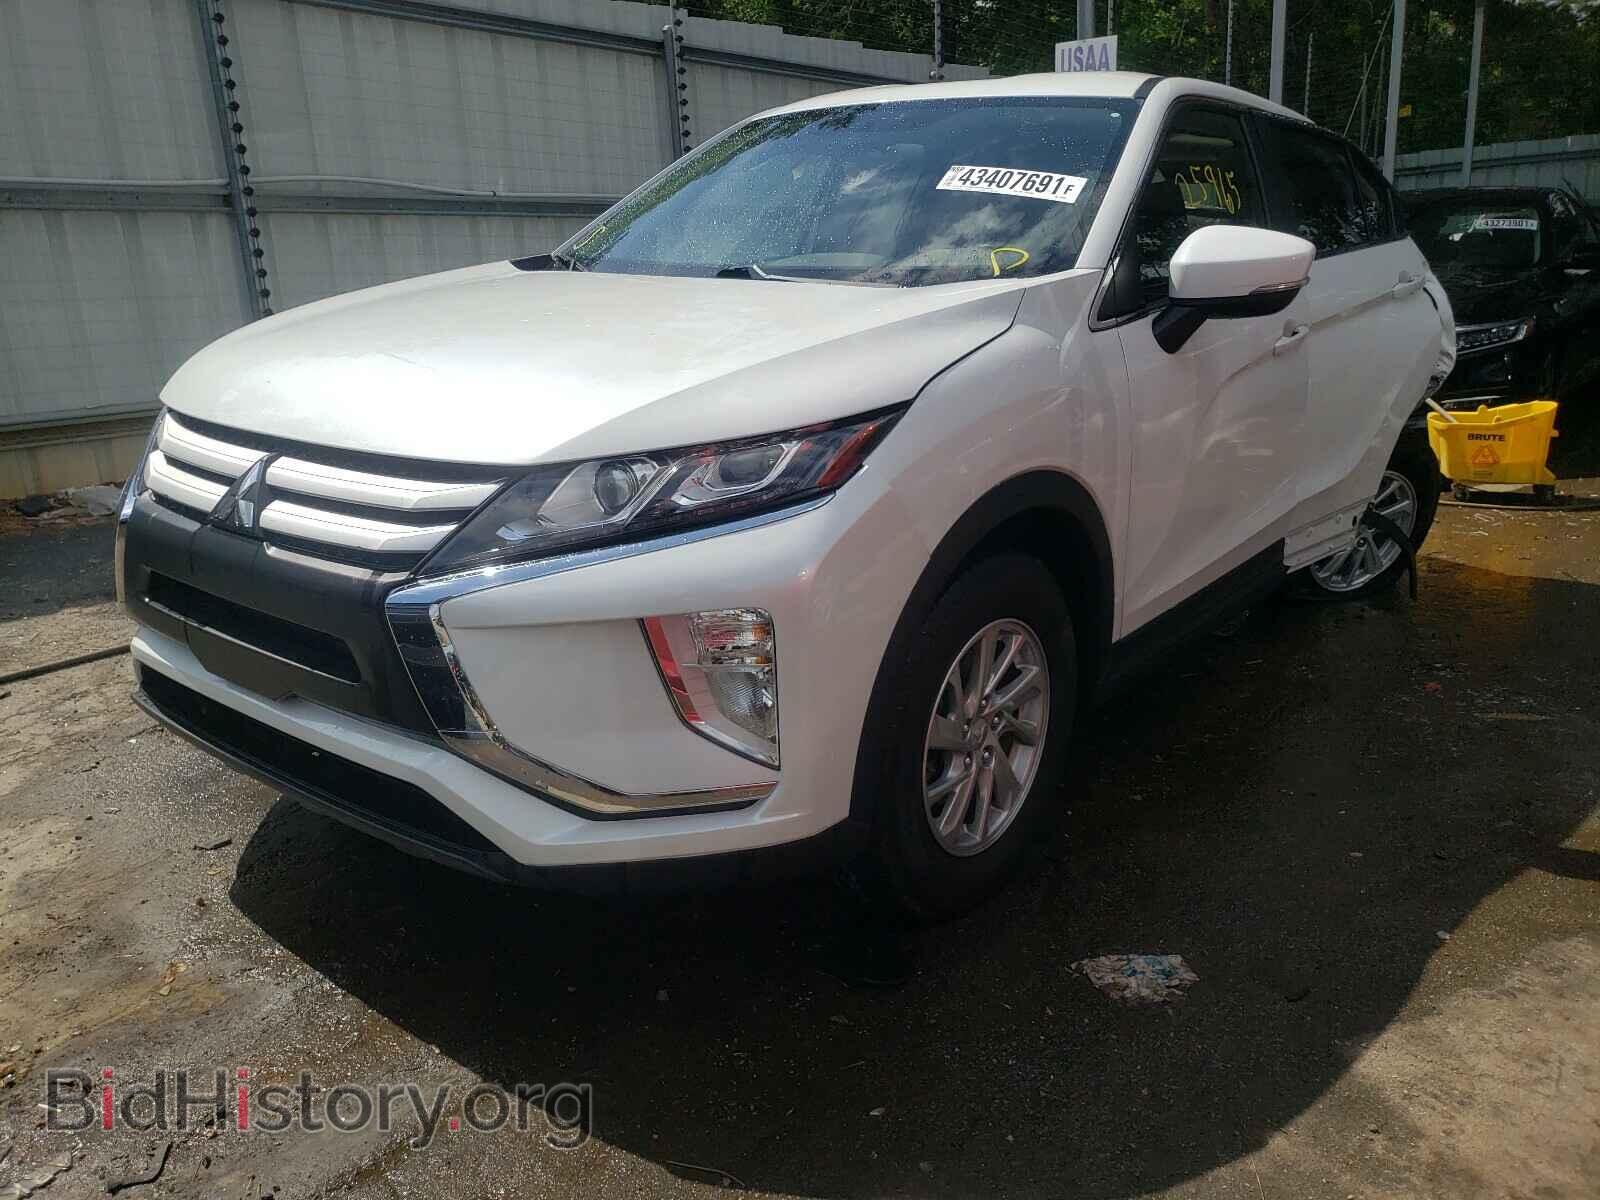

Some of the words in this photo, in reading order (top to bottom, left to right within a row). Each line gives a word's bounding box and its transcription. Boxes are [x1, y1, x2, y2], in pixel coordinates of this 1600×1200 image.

[1060, 44, 1110, 72] USAA
[958, 168, 1066, 195] 43407691
[1064, 184, 1075, 195] F
[1467, 432, 1505, 442] BRUTE
